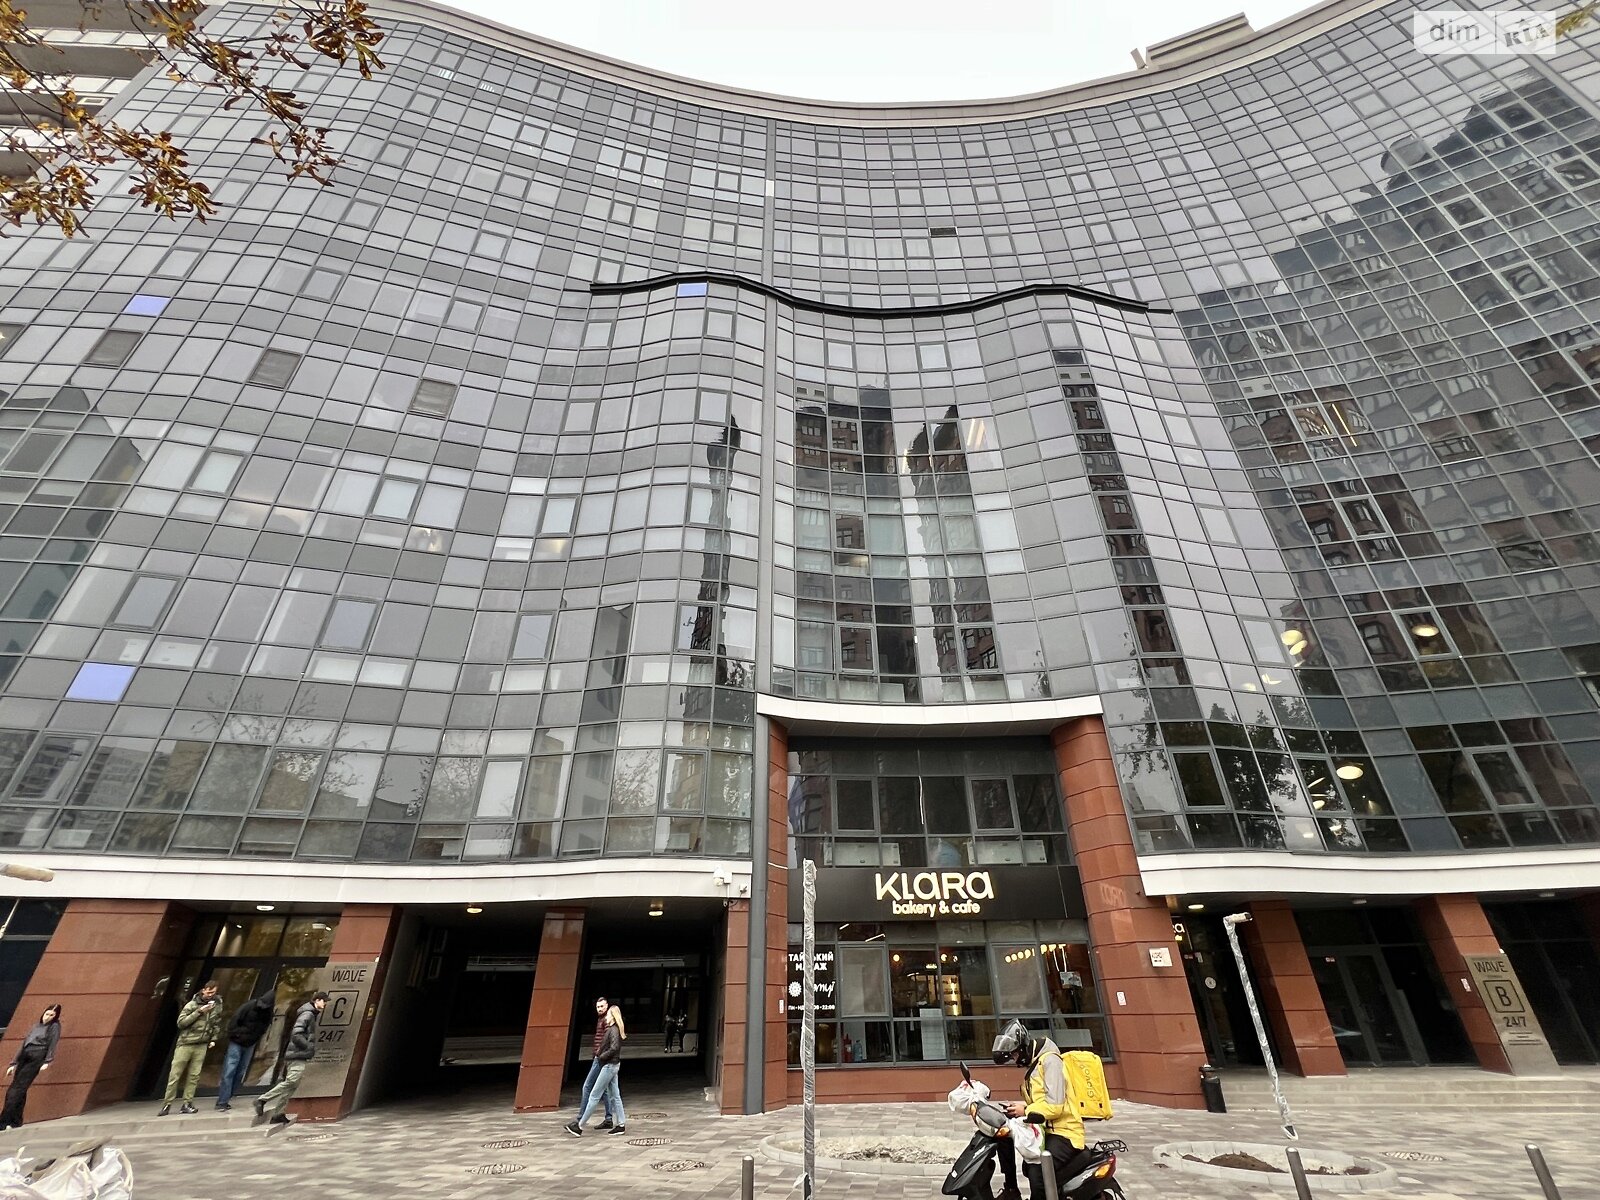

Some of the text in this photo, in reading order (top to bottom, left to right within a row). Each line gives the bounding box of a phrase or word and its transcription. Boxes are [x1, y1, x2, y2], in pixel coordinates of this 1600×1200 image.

[892, 899, 981, 918] bakery & cafe
[1474, 960, 1509, 973] WAVE
[331, 969, 367, 982] WAVE
[1494, 986, 1512, 1007] B
[332, 997, 347, 1020] C
[1502, 1016, 1527, 1028] 24/7
[318, 1031, 345, 1043] 24/7
